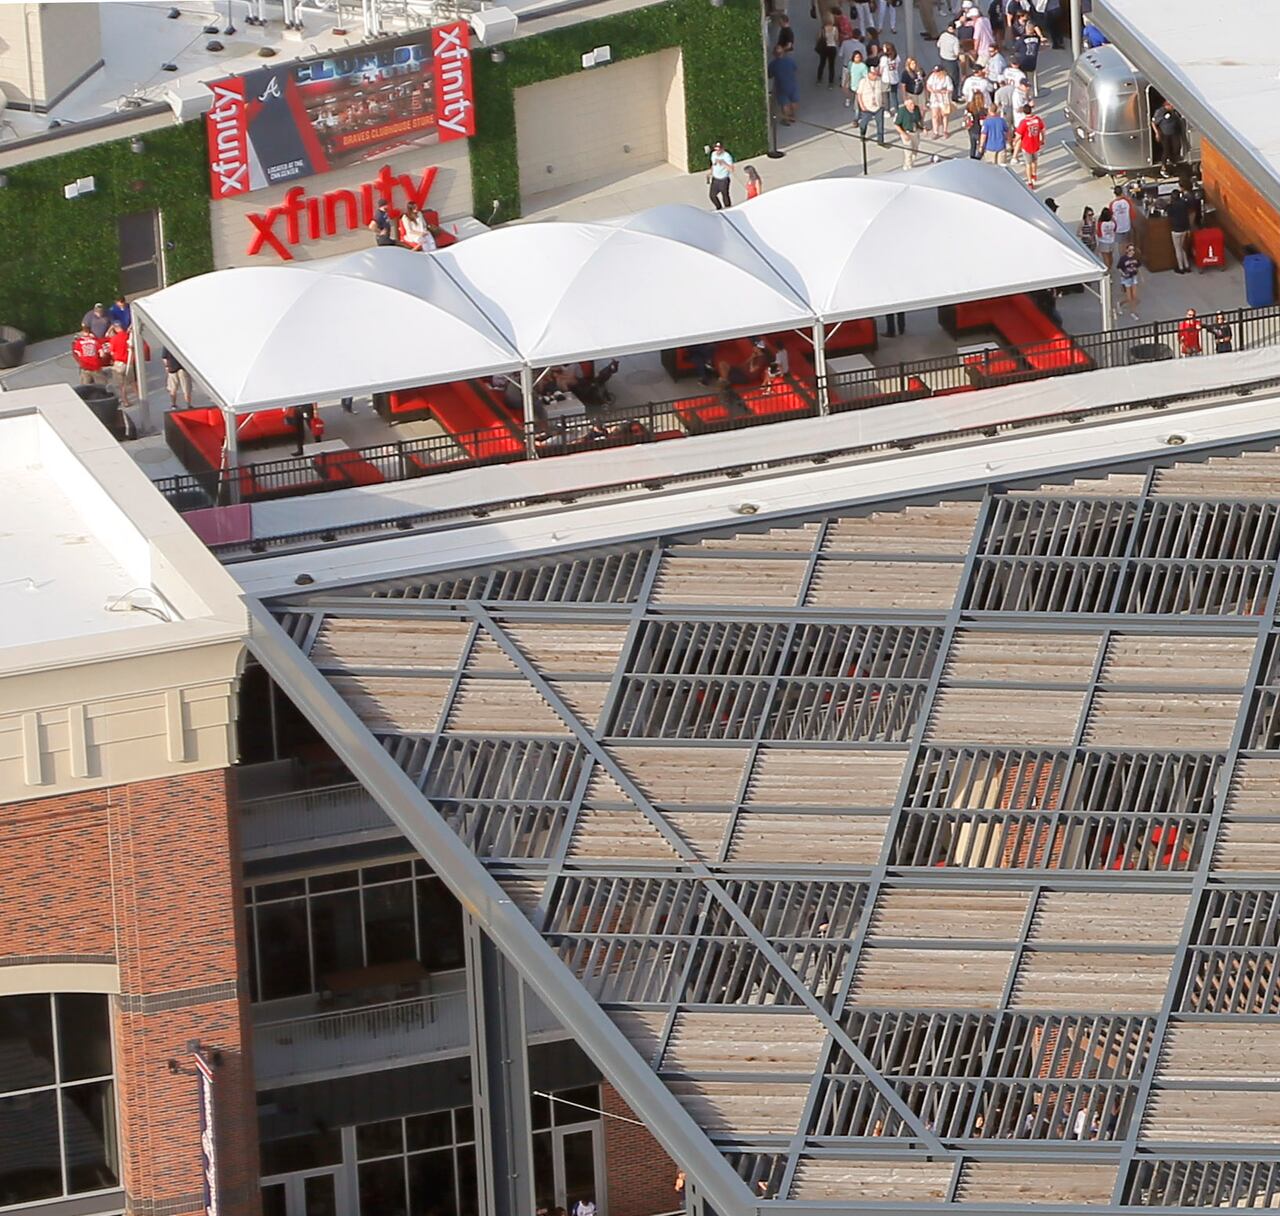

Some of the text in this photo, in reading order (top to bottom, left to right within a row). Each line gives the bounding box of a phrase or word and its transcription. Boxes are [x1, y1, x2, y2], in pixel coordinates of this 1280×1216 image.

[434, 26, 473, 134] xfinity
[209, 86, 247, 194] xfinity
[246, 164, 439, 261] xfinity
